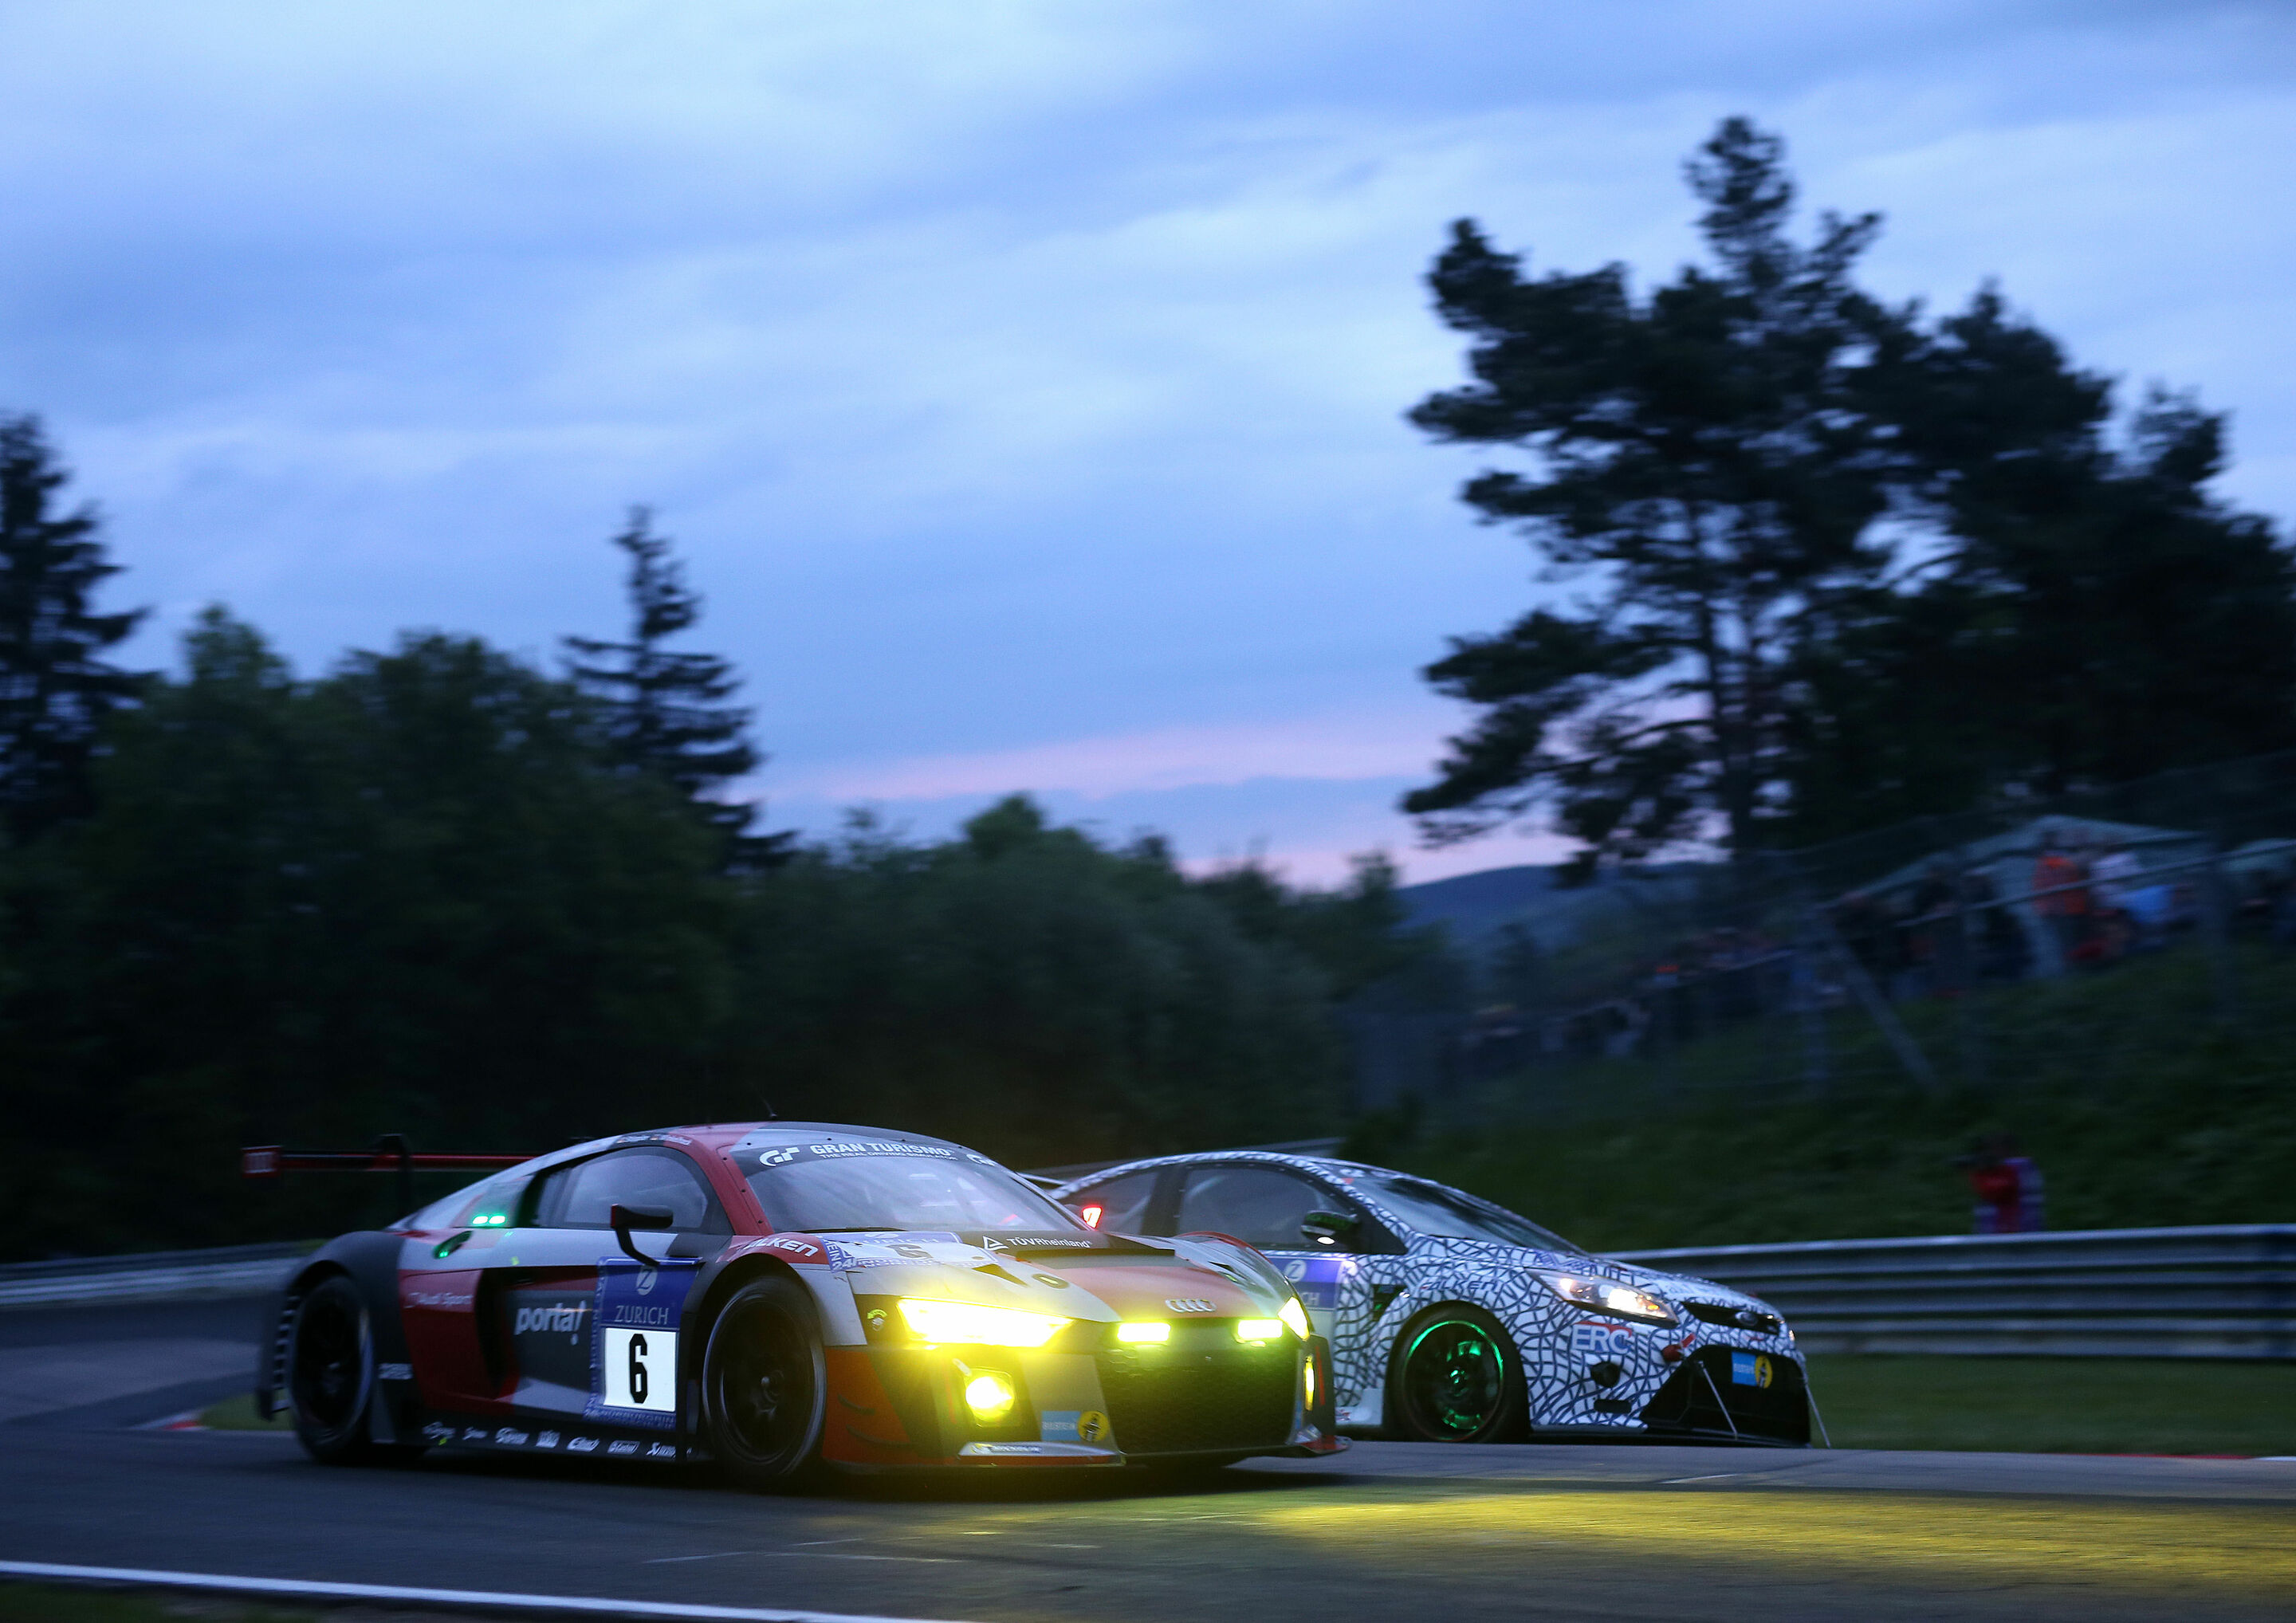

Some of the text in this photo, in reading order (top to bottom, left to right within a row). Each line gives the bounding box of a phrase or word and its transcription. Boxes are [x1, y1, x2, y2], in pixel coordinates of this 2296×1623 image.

[809, 1143, 867, 1154] GRAN
[1419, 1280, 1498, 1291] FALKEN
[513, 1300, 586, 1346] porta!
[614, 1305, 669, 1325] ZURICH
[1572, 1323, 1632, 1354] ERC
[629, 1334, 647, 1403] 6
